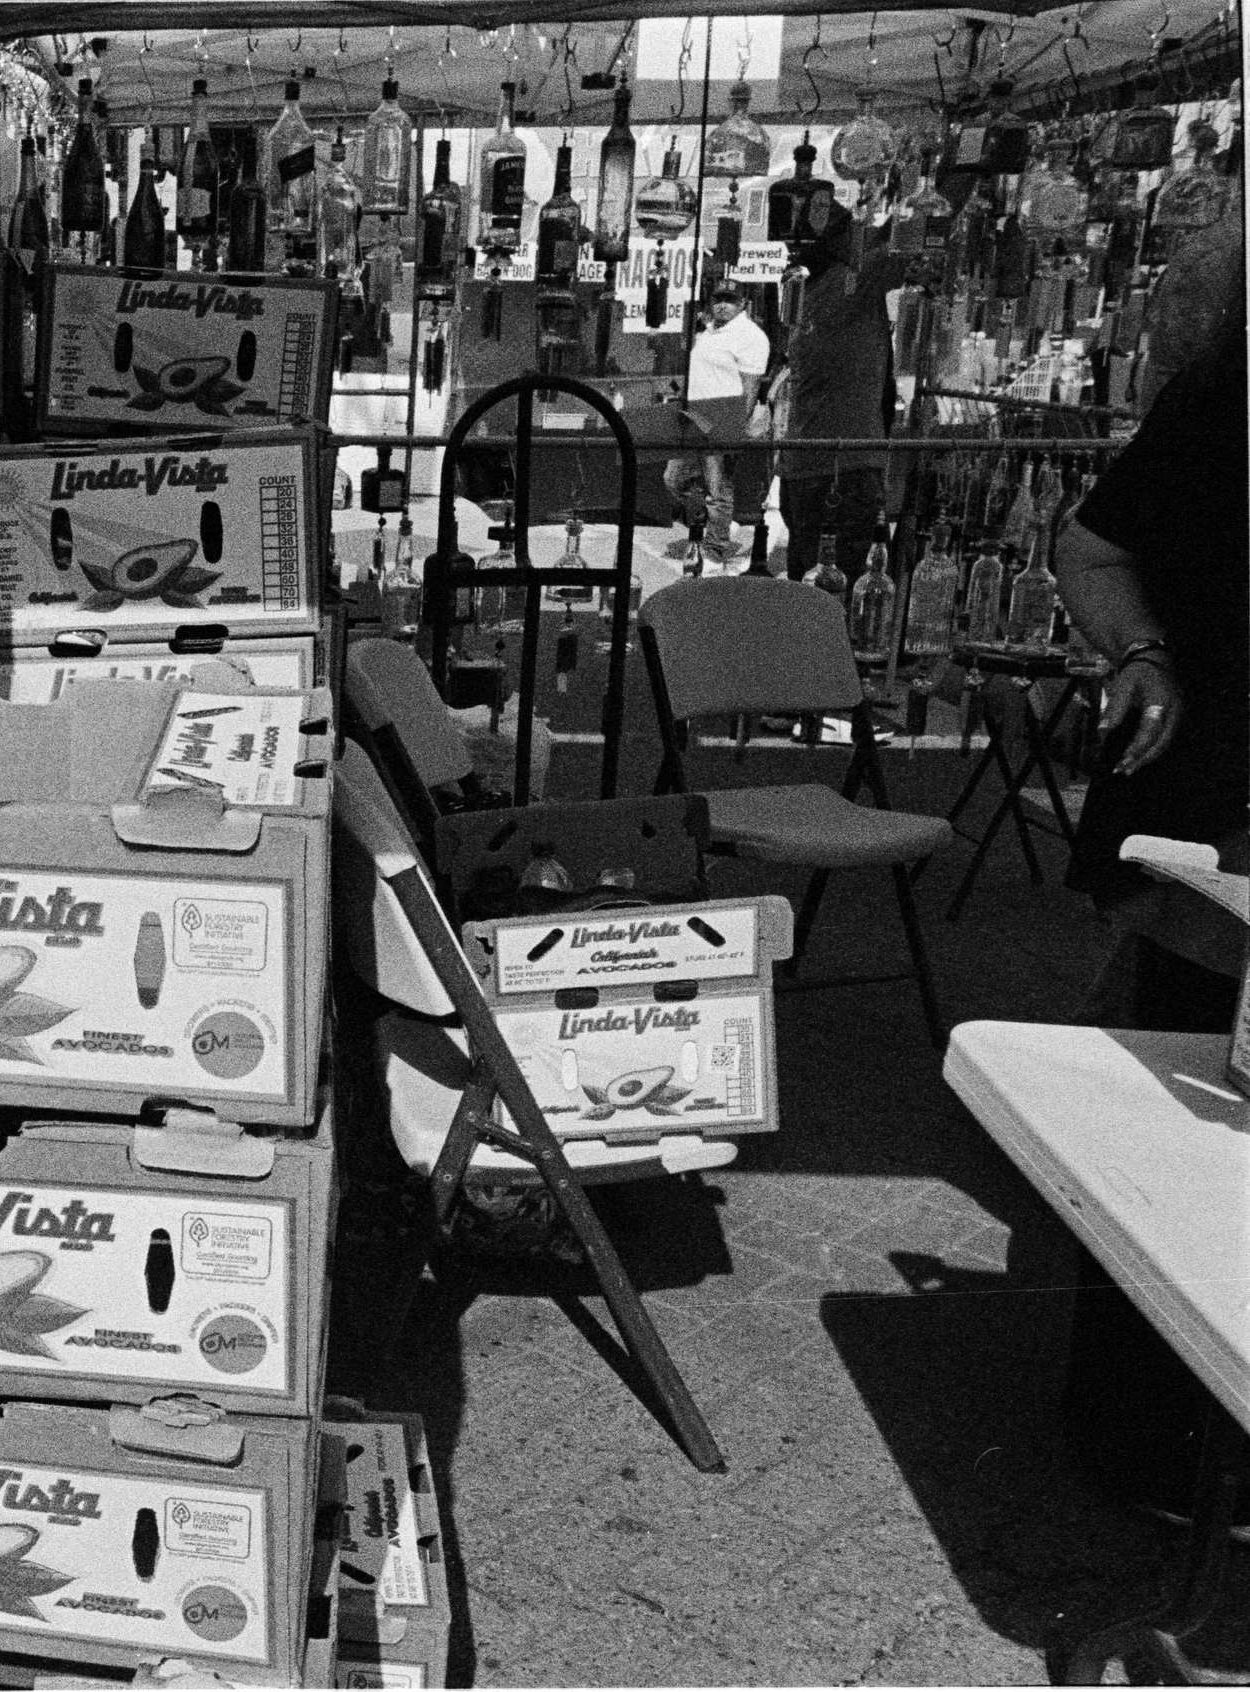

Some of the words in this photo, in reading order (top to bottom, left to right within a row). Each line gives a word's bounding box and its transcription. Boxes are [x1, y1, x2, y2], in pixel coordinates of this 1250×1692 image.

[738, 247, 782, 259] rewed
[759, 263, 784, 274] Tea
[117, 280, 265, 318] Linda-Vista
[625, 303, 682, 319] LEMDE
[51, 456, 229, 500] Linda-Vista
[259, 475, 296, 485] COUNT
[279, 488, 291, 496] 20
[280, 500, 292, 509] 24
[280, 524, 292, 533] 32
[281, 550, 293, 558] 40
[282, 575, 294, 584] 60
[283, 588, 295, 596] 70
[204, 912, 260, 924] SUSTAINABLE
[571, 921, 682, 948] Linda-Vista
[576, 961, 678, 976] AVOCADOS
[558, 1006, 701, 1040] Linda-Vista
[83, 1030, 145, 1042] FINEST
[52, 1038, 174, 1057] AVOCADOS
[211, 1226, 266, 1237] SUSTAINABLE
[94, 1328, 154, 1340] FINEST
[64, 1335, 183, 1354] AVOCADOS
[54, 1598, 166, 1620] AVOCADOS
